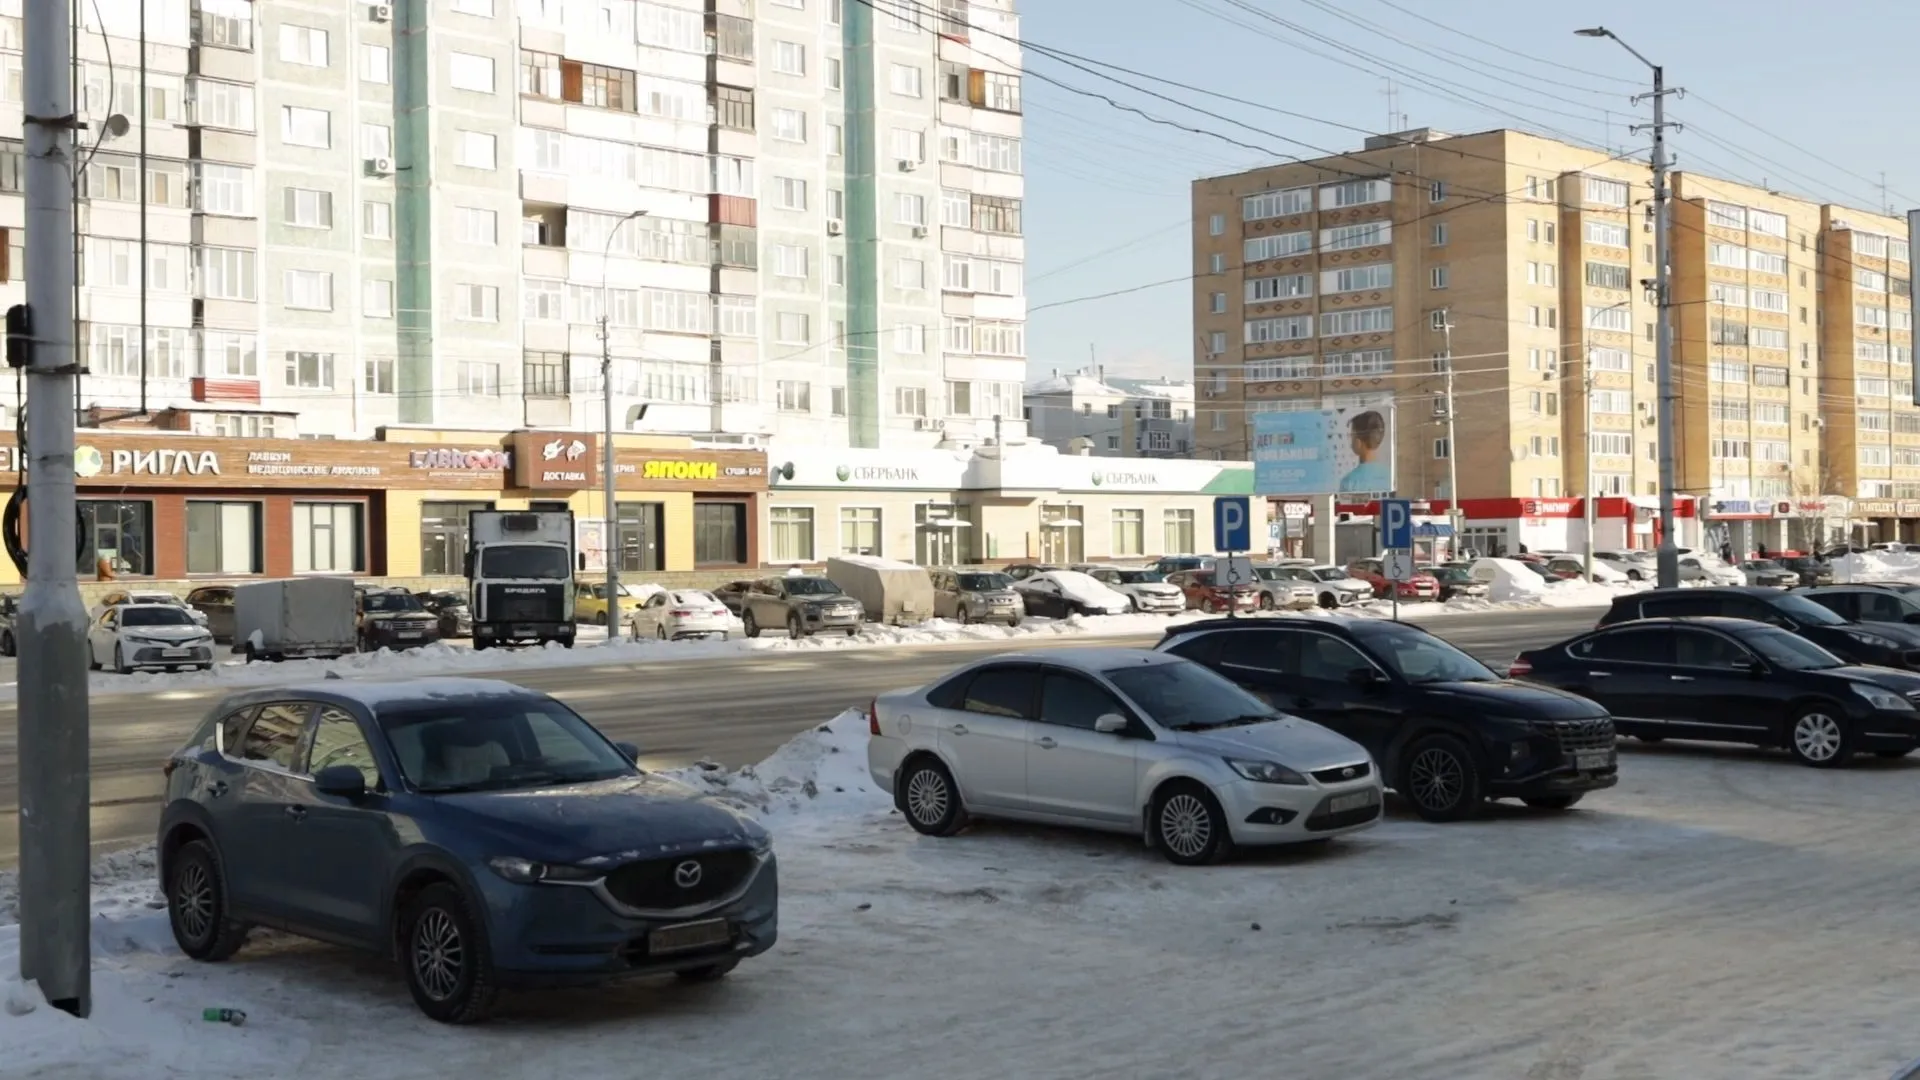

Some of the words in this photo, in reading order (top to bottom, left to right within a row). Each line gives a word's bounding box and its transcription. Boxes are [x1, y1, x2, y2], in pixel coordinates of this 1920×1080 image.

[112, 449, 220, 475] РИГЛА
[247, 464, 328, 475] МЕДИЦИНСКИЕ
[542, 471, 586, 481] ДОСТАВКА
[643, 461, 718, 480] ЯПОКИ
[854, 466, 919, 481] СБЕРБАНК
[1106, 471, 1158, 485] СБЕРБАНК
[1284, 502, 1311, 515] OZON
[1222, 501, 1243, 548] P
[1272, 525, 1279, 537] P
[1387, 503, 1405, 545] P
